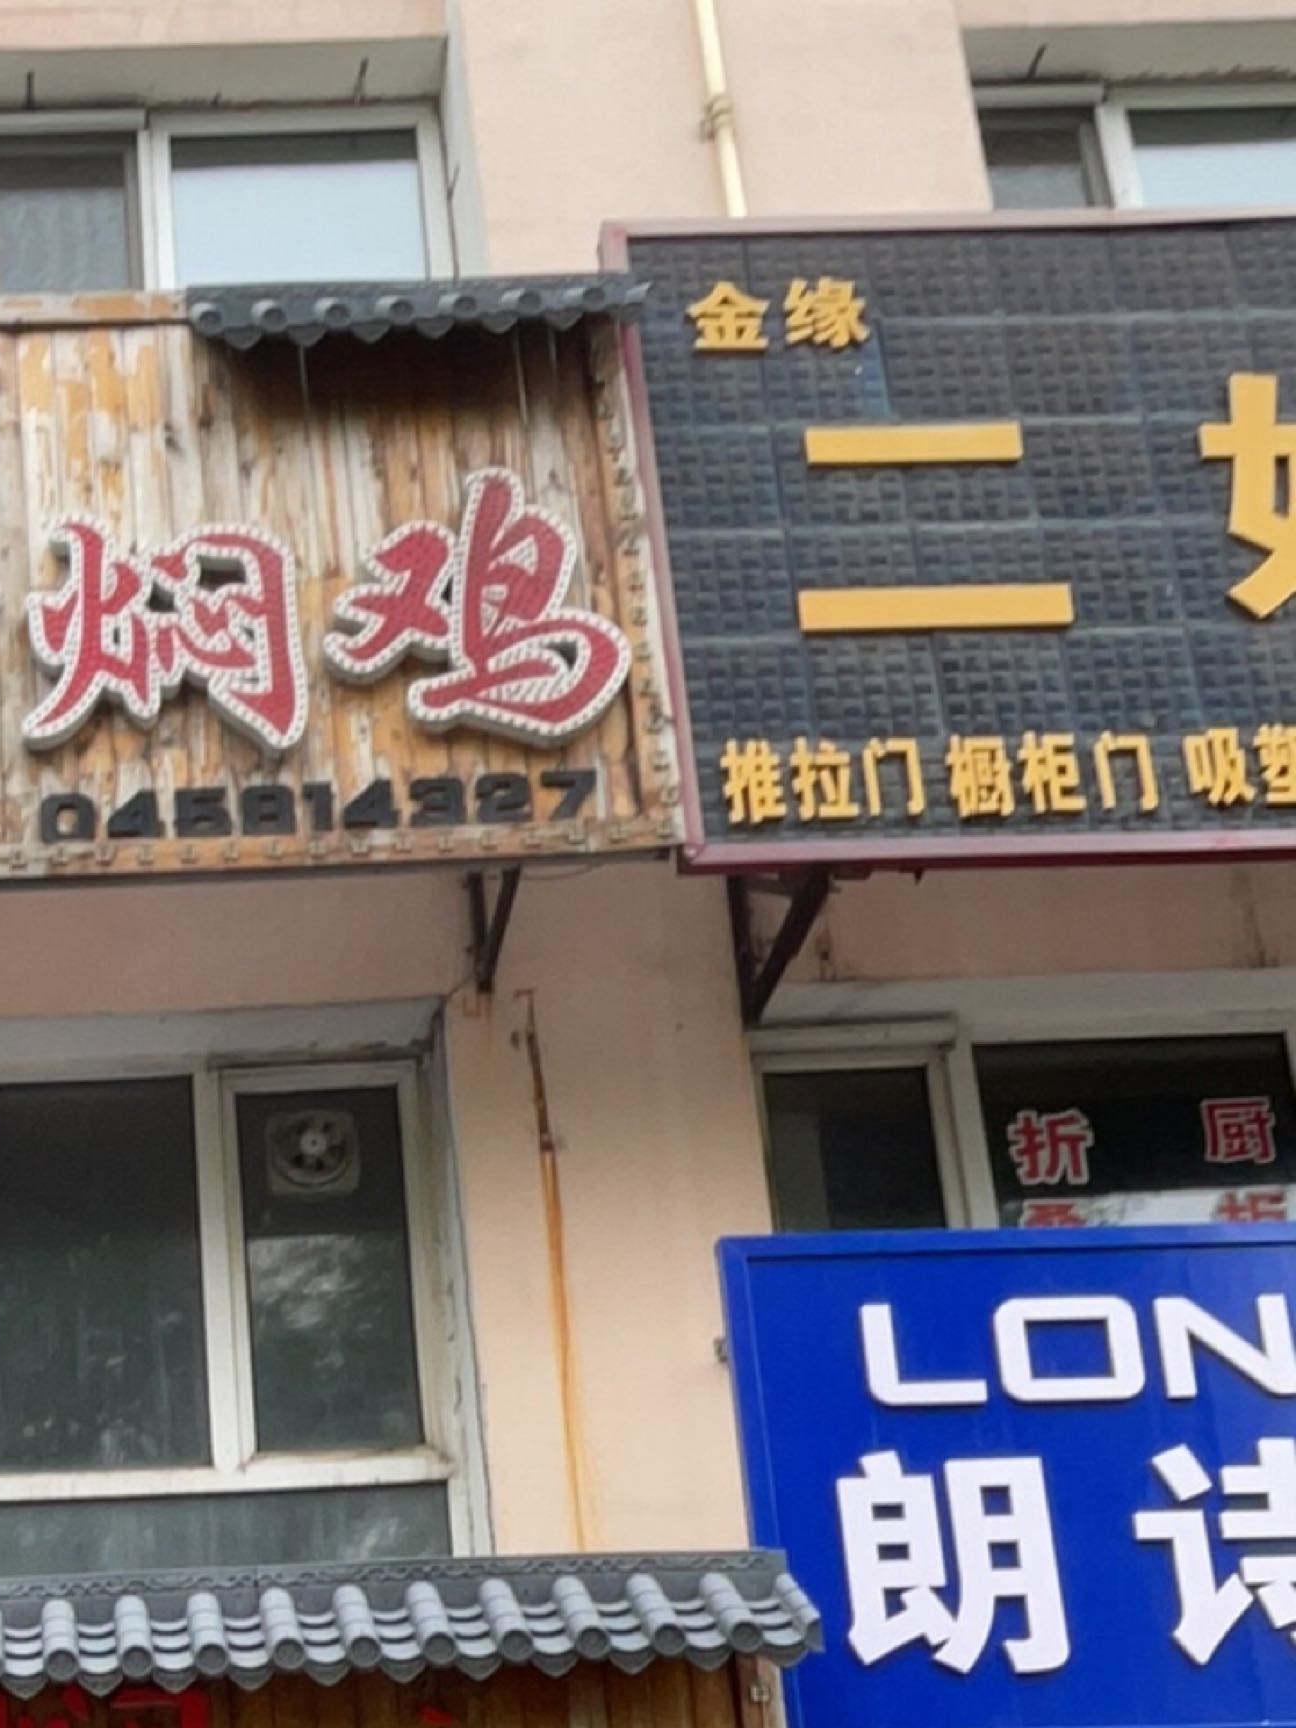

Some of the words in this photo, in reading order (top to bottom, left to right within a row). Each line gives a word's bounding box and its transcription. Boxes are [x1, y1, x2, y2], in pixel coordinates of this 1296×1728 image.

[686, 275, 870, 353] 金缘
[721, 738, 926, 823] 推拉门
[946, 730, 1160, 819] 橱柜门
